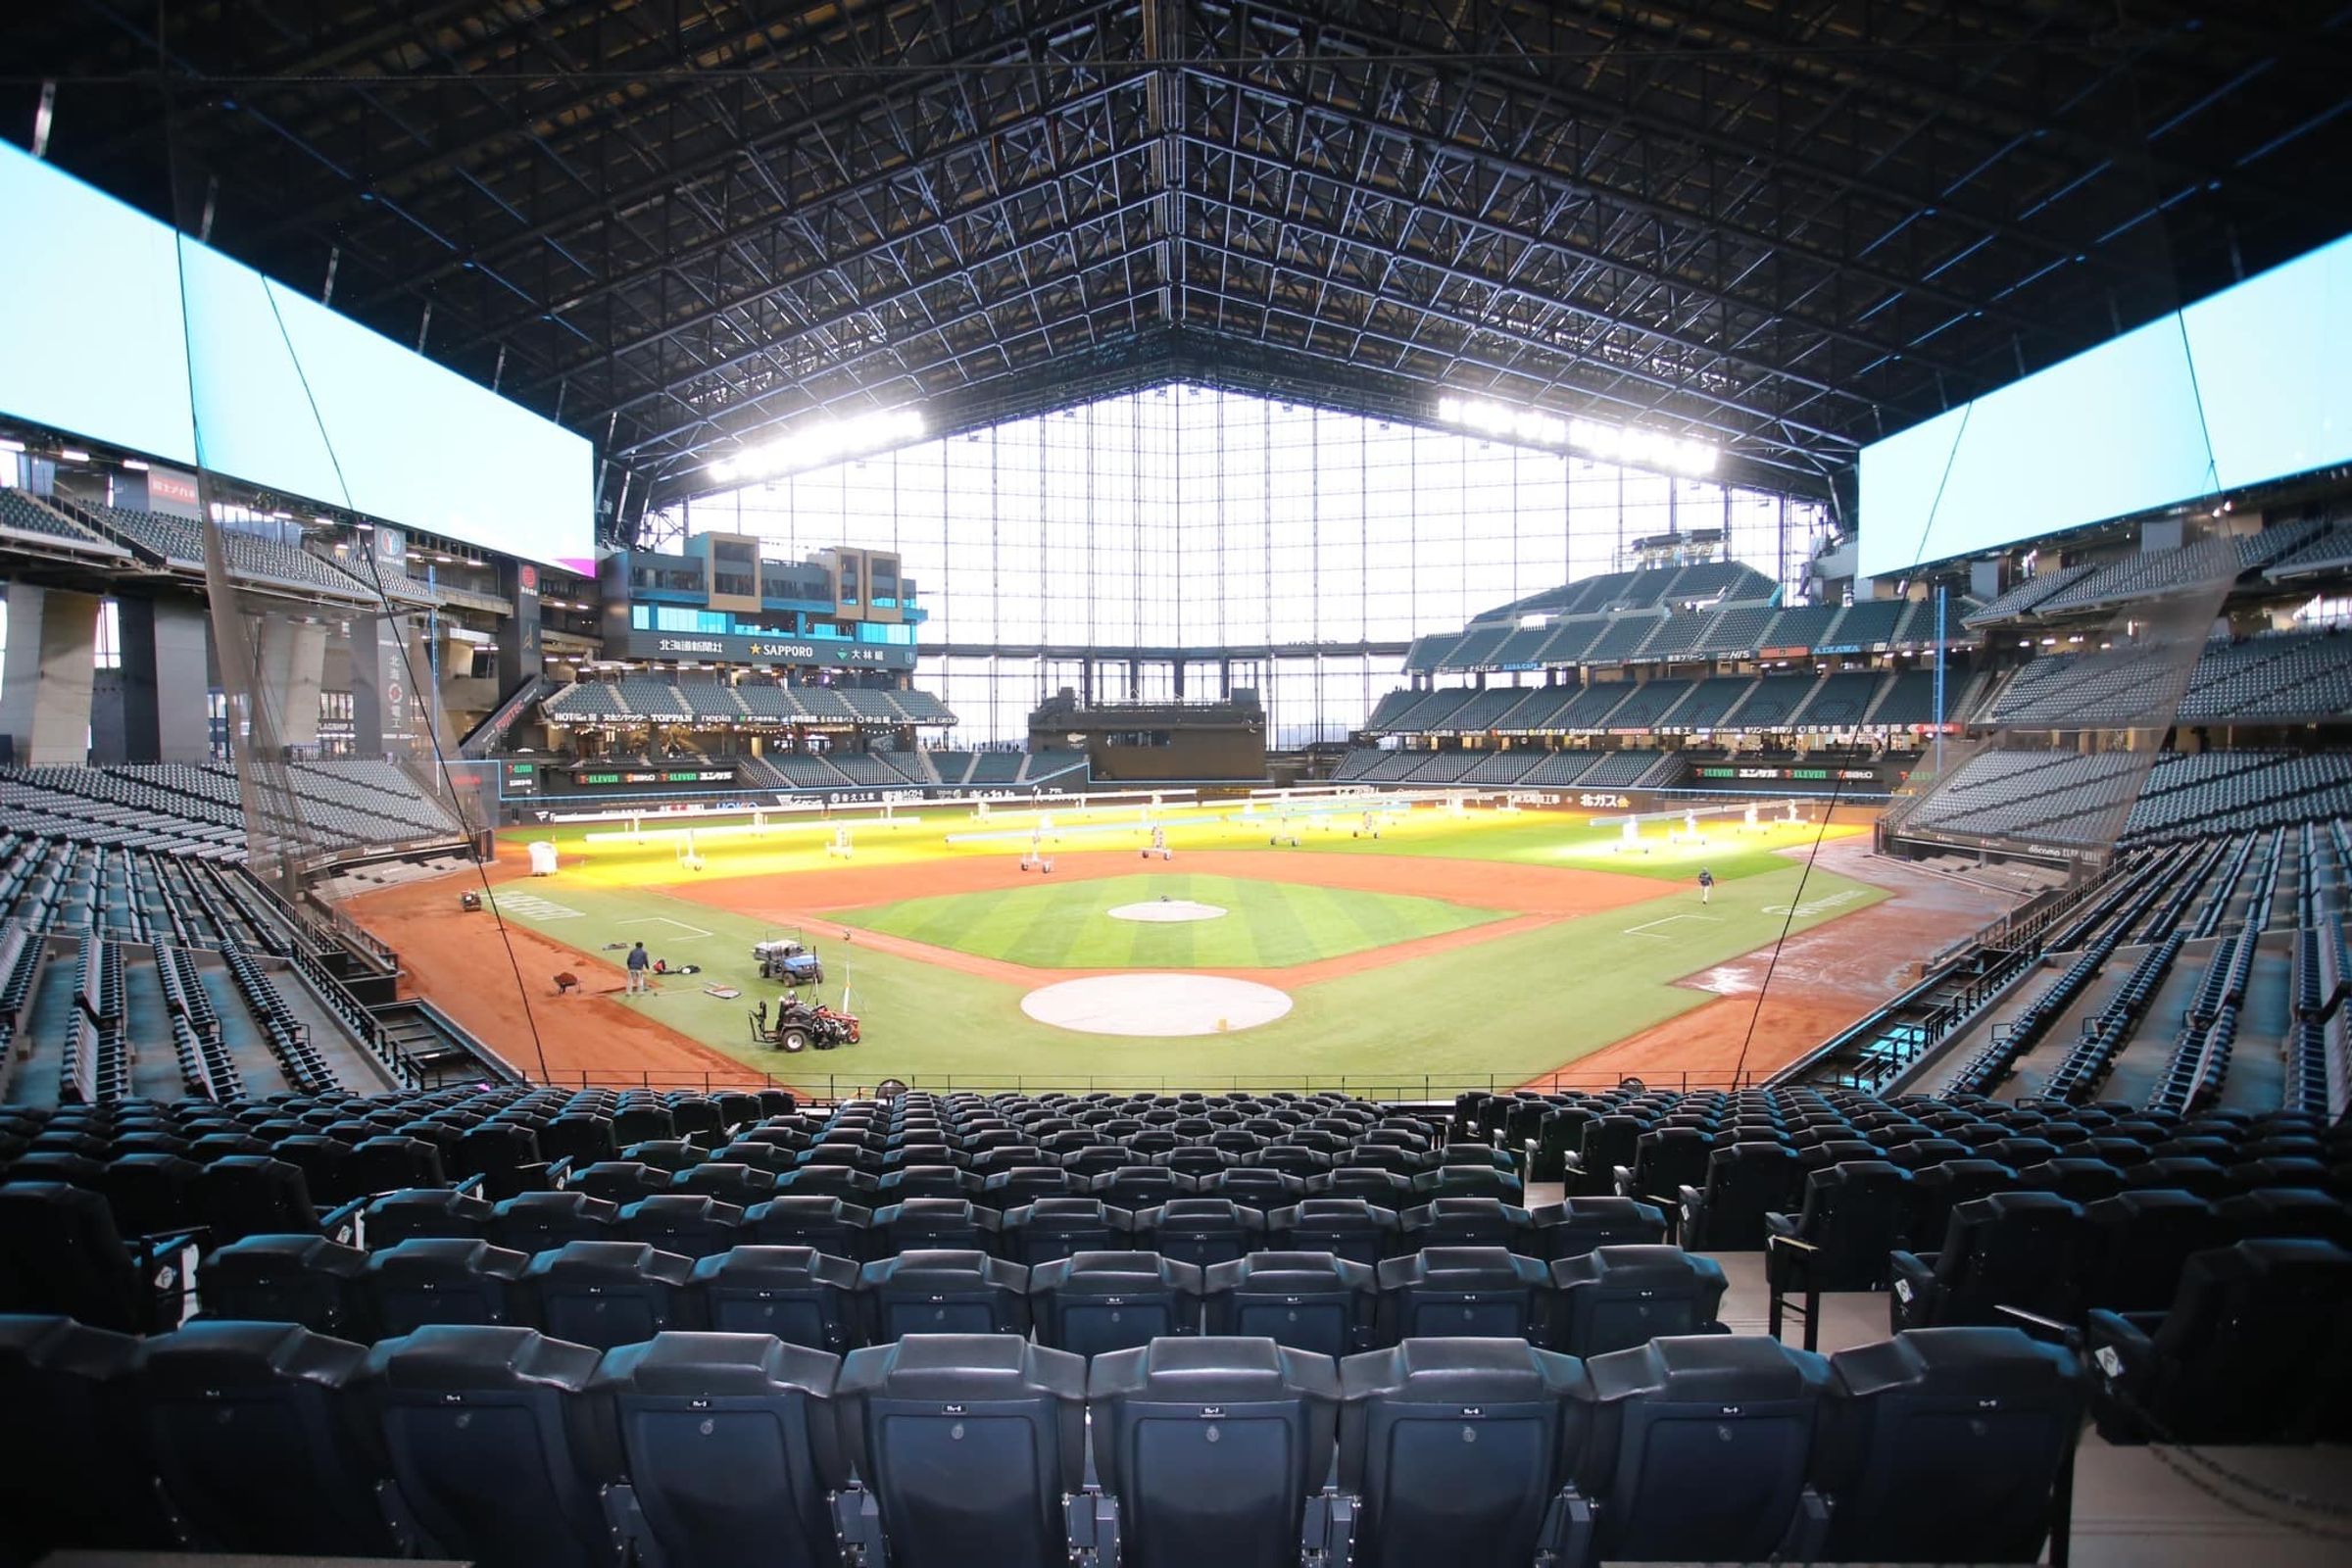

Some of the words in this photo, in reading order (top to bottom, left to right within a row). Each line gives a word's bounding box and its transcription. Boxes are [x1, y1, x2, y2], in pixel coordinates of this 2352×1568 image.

[762, 645, 813, 658] SAPPORO
[495, 700, 524, 731] FUJITEC
[651, 713, 693, 722] TOPPAN
[701, 713, 731, 723] nepia
[1580, 794, 1618, 808] 北ガス
[2029, 844, 2060, 857] docomo
